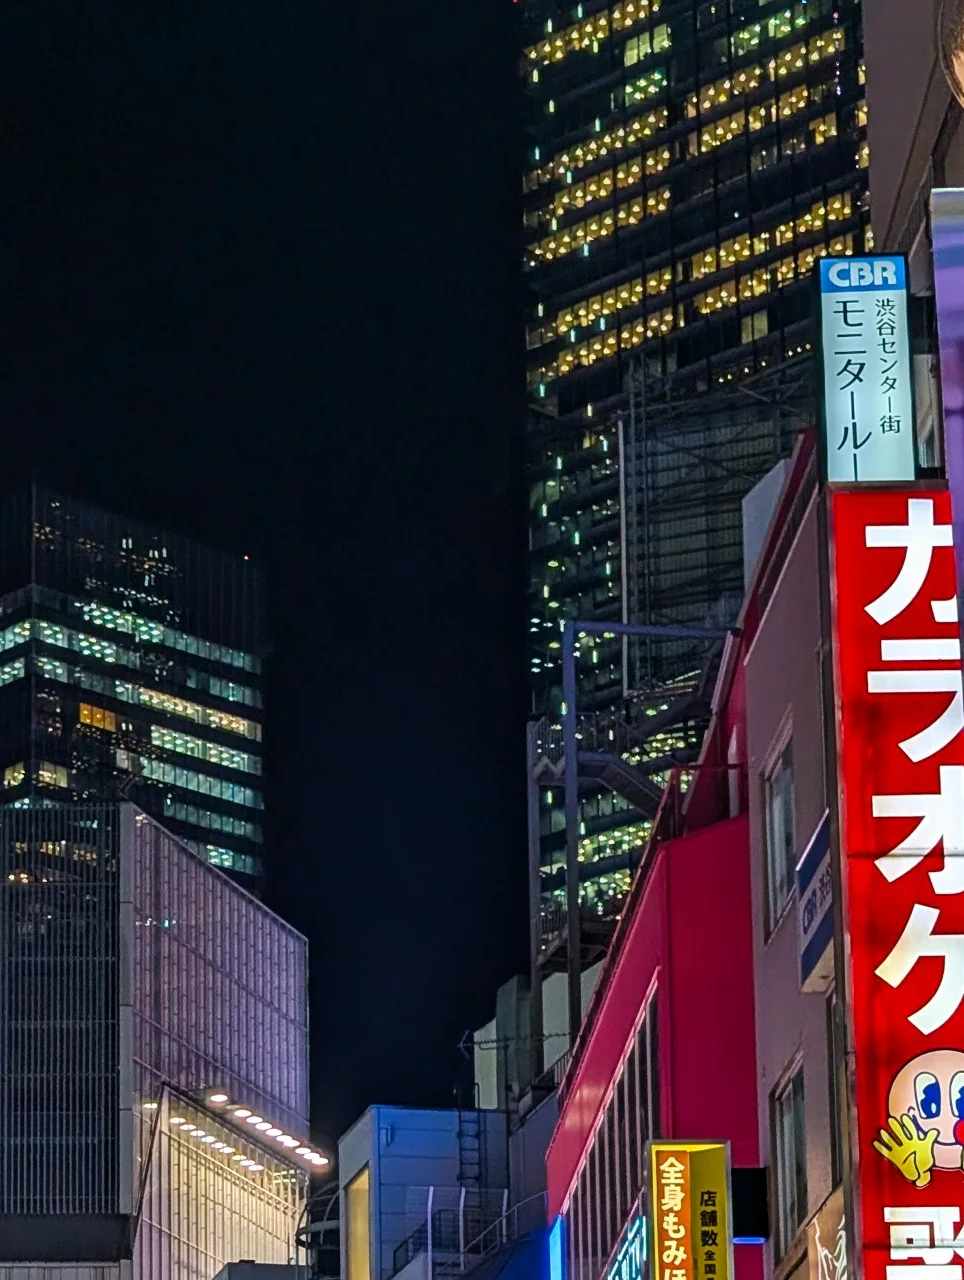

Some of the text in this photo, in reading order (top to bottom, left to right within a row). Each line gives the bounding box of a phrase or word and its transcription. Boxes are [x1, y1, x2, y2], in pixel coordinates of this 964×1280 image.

[828, 261, 897, 289] CBR
[875, 298, 902, 434] 渋谷センター街
